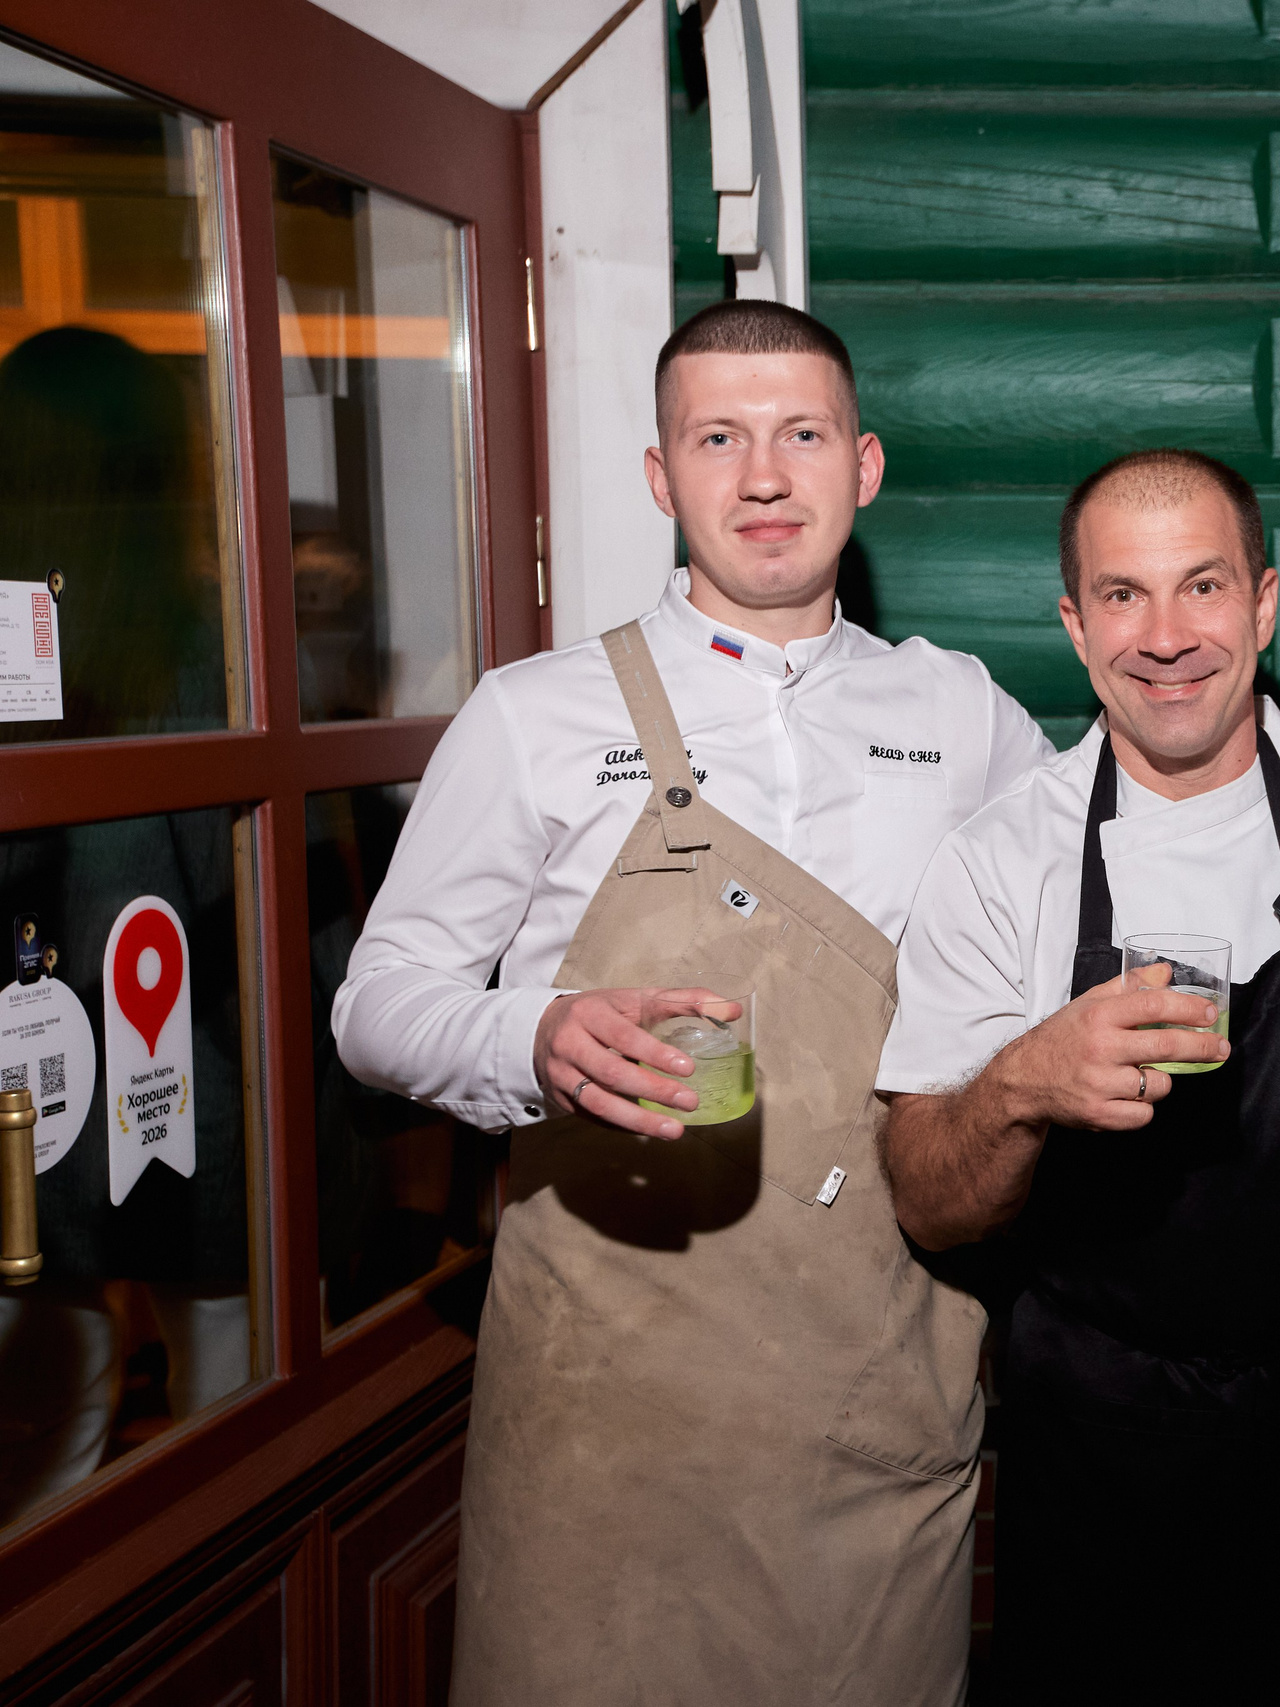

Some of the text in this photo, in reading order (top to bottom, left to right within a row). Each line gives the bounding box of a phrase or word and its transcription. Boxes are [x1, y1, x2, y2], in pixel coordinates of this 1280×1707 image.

[868, 744, 942, 764] HEAD CHEF
[9, 992, 32, 1004] RAKUSA
[32, 987, 52, 998] GROUP
[130, 1066, 175, 1086] Яндекс Карты
[127, 1083, 179, 1110] Хорошее
[137, 1102, 171, 1124] место
[141, 1123, 168, 1146] 2026
